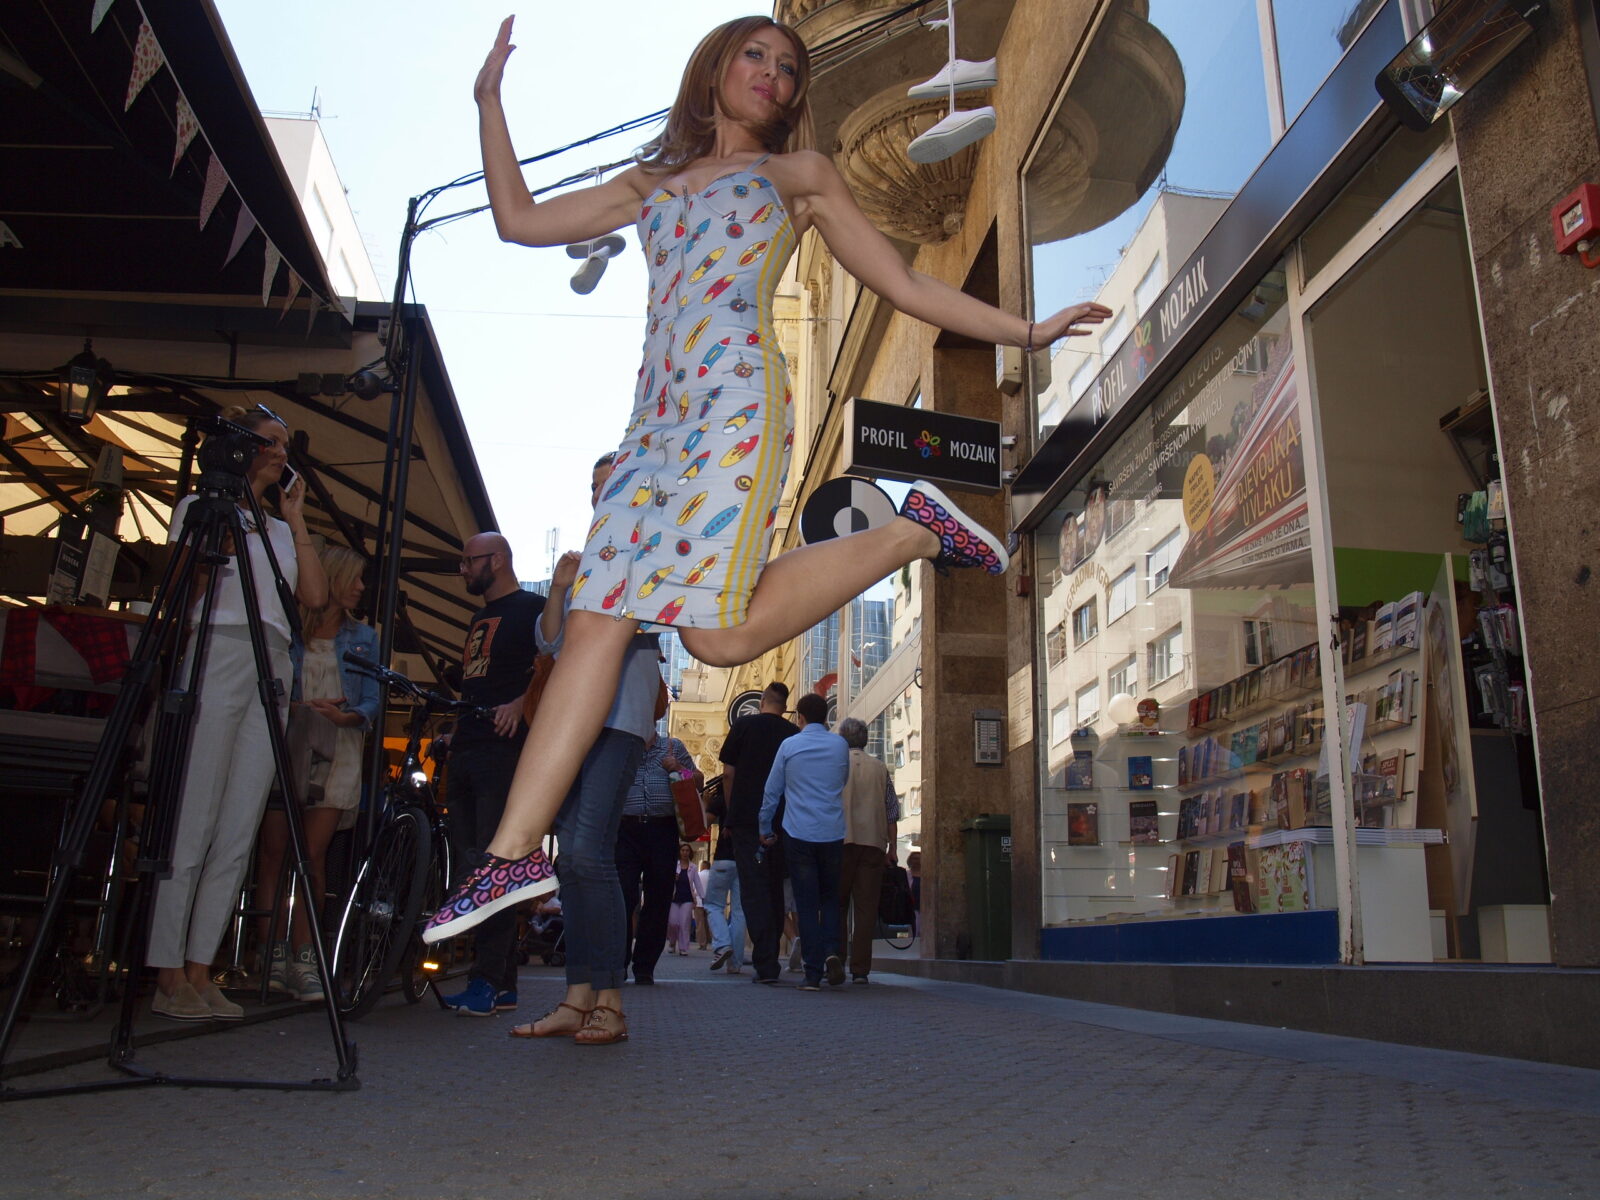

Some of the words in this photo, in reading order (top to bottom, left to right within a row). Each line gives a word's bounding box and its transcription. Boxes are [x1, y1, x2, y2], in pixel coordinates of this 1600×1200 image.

[1092, 360, 1127, 425] PROFIL
[1160, 255, 1209, 343] MOZAIK
[861, 425, 908, 449] PROFIL
[950, 440, 996, 464] MOZAIK
[1148, 427, 1190, 477] SAVRŠENOM
[1237, 416, 1299, 505] DJEVOJKA
[1242, 504, 1250, 527] U
[1250, 462, 1293, 521] VLAKU
[1281, 537, 1307, 553] VAMA.
[1284, 518, 1304, 535] ONA.
